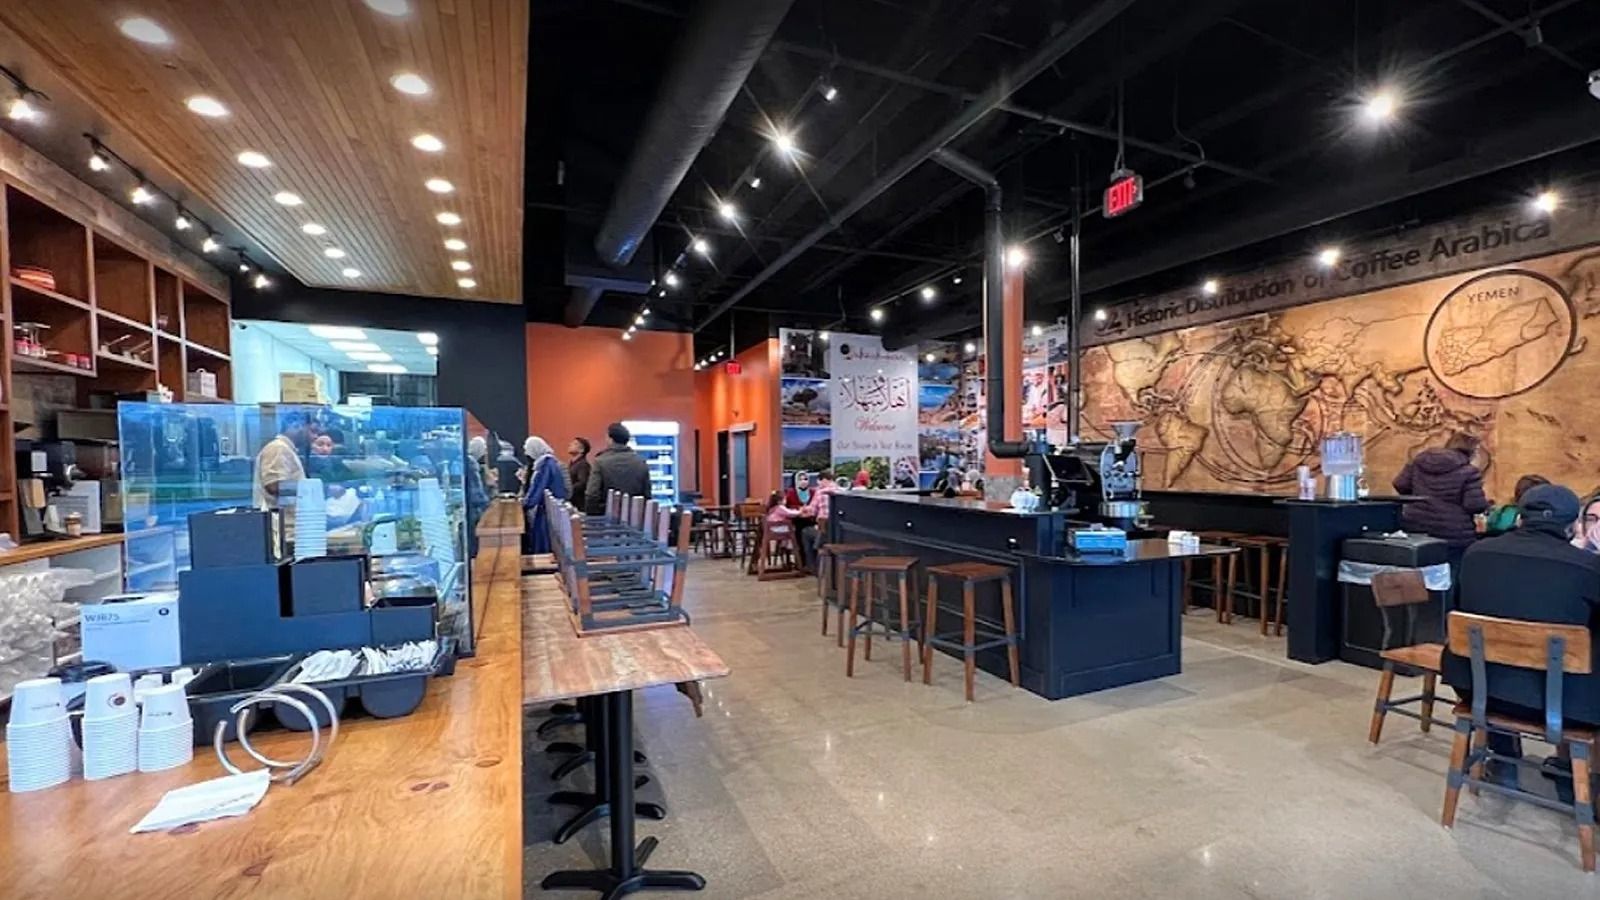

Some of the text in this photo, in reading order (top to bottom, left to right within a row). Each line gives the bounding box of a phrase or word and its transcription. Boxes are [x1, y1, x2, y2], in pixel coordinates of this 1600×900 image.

[1108, 176, 1137, 214] EXIT
[1127, 302, 1183, 328] Historic
[1185, 277, 1295, 314] Distribution
[1335, 250, 1421, 283] Coffee
[1428, 218, 1550, 262] Arabica
[1466, 286, 1520, 304] YEMEN
